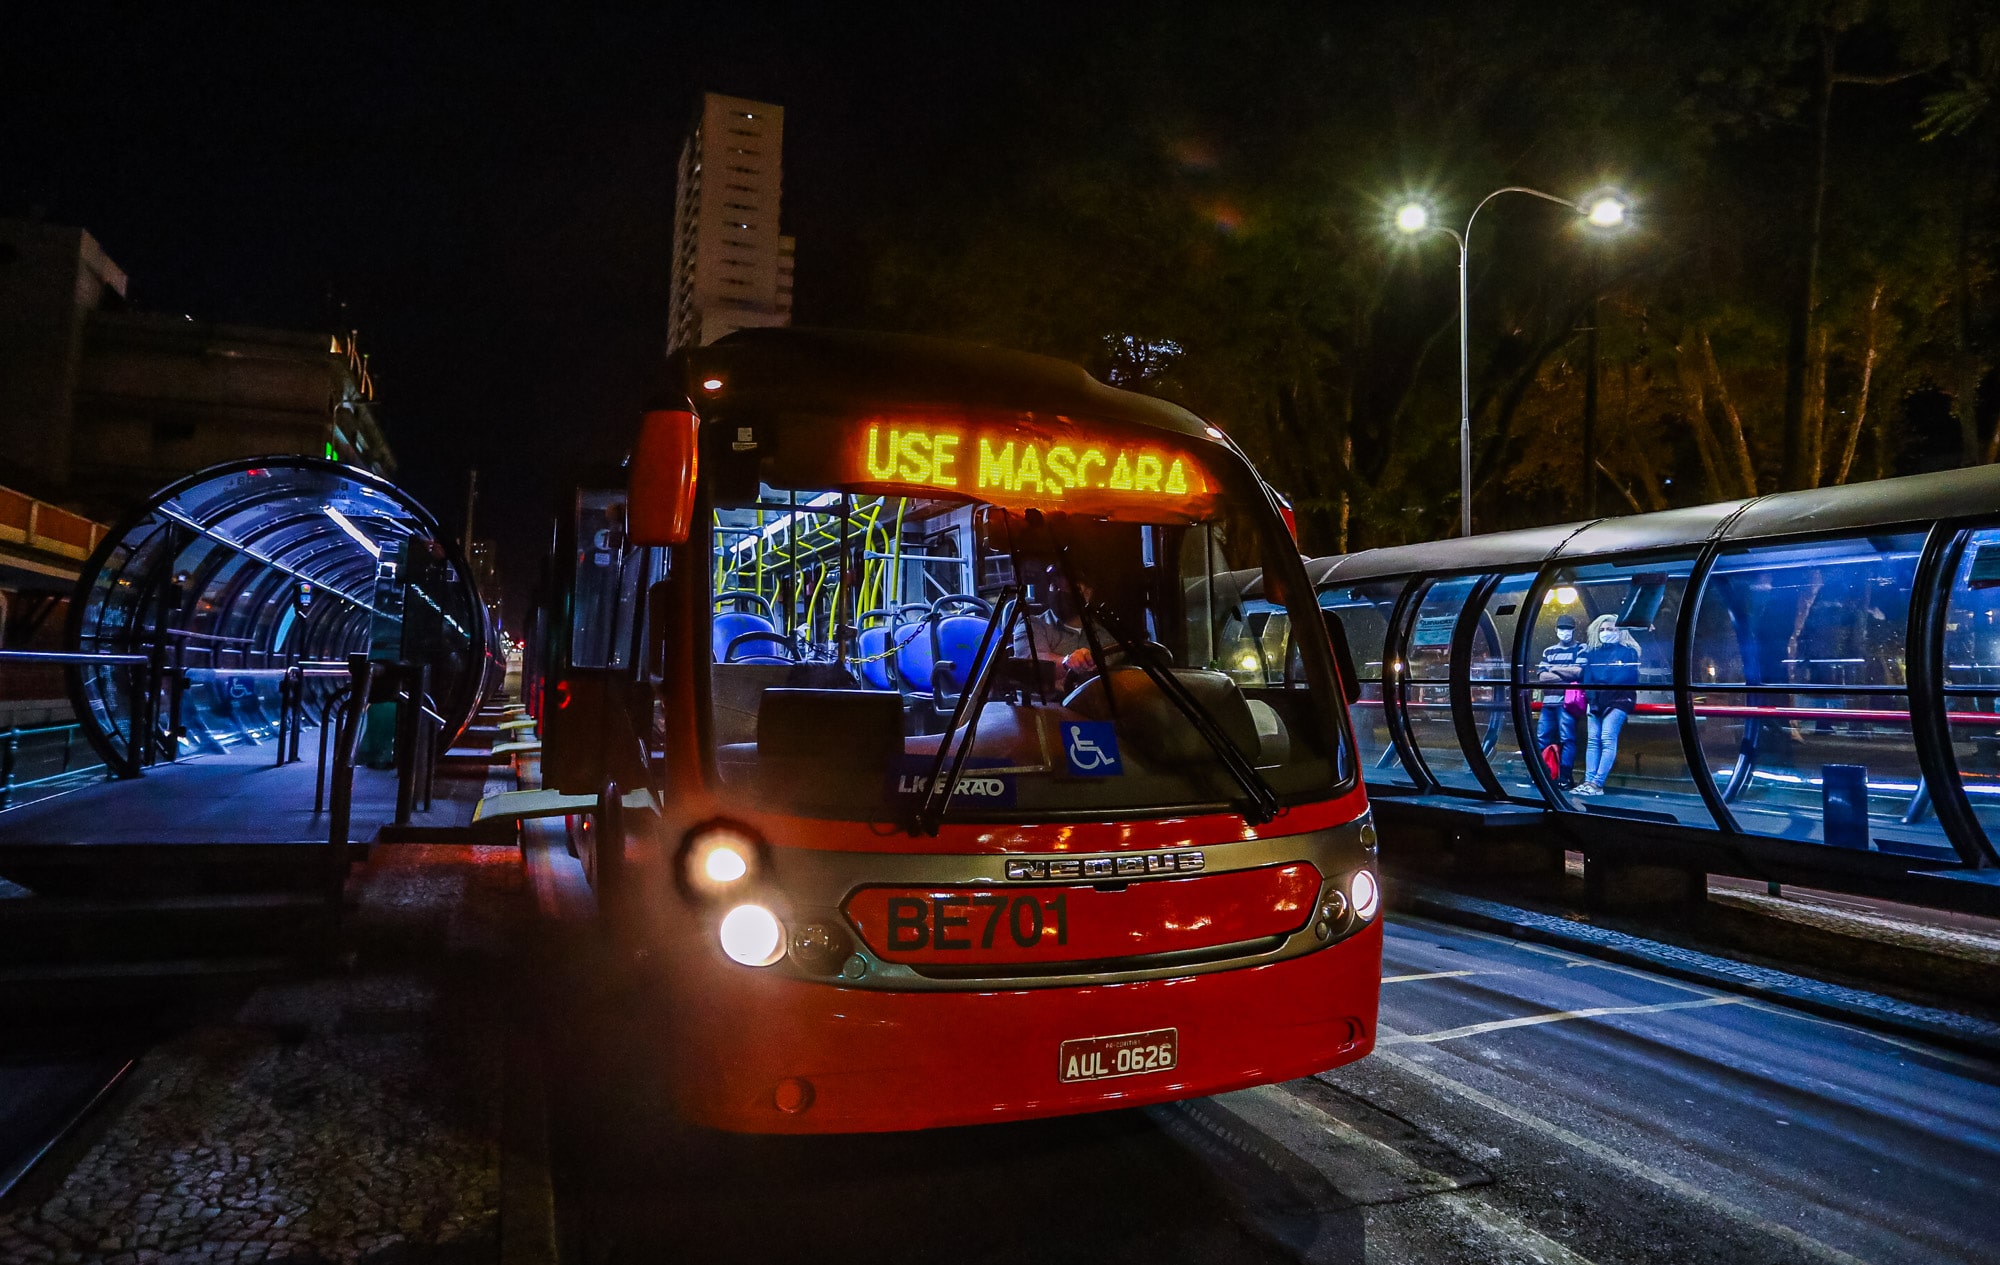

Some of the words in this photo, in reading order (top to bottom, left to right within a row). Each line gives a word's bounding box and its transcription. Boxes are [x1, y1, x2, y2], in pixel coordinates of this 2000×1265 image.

[867, 425, 960, 486] USE
[977, 437, 1188, 495] MASCARA
[1008, 852, 1204, 879] NEOBUS
[887, 893, 1069, 951] BE701
